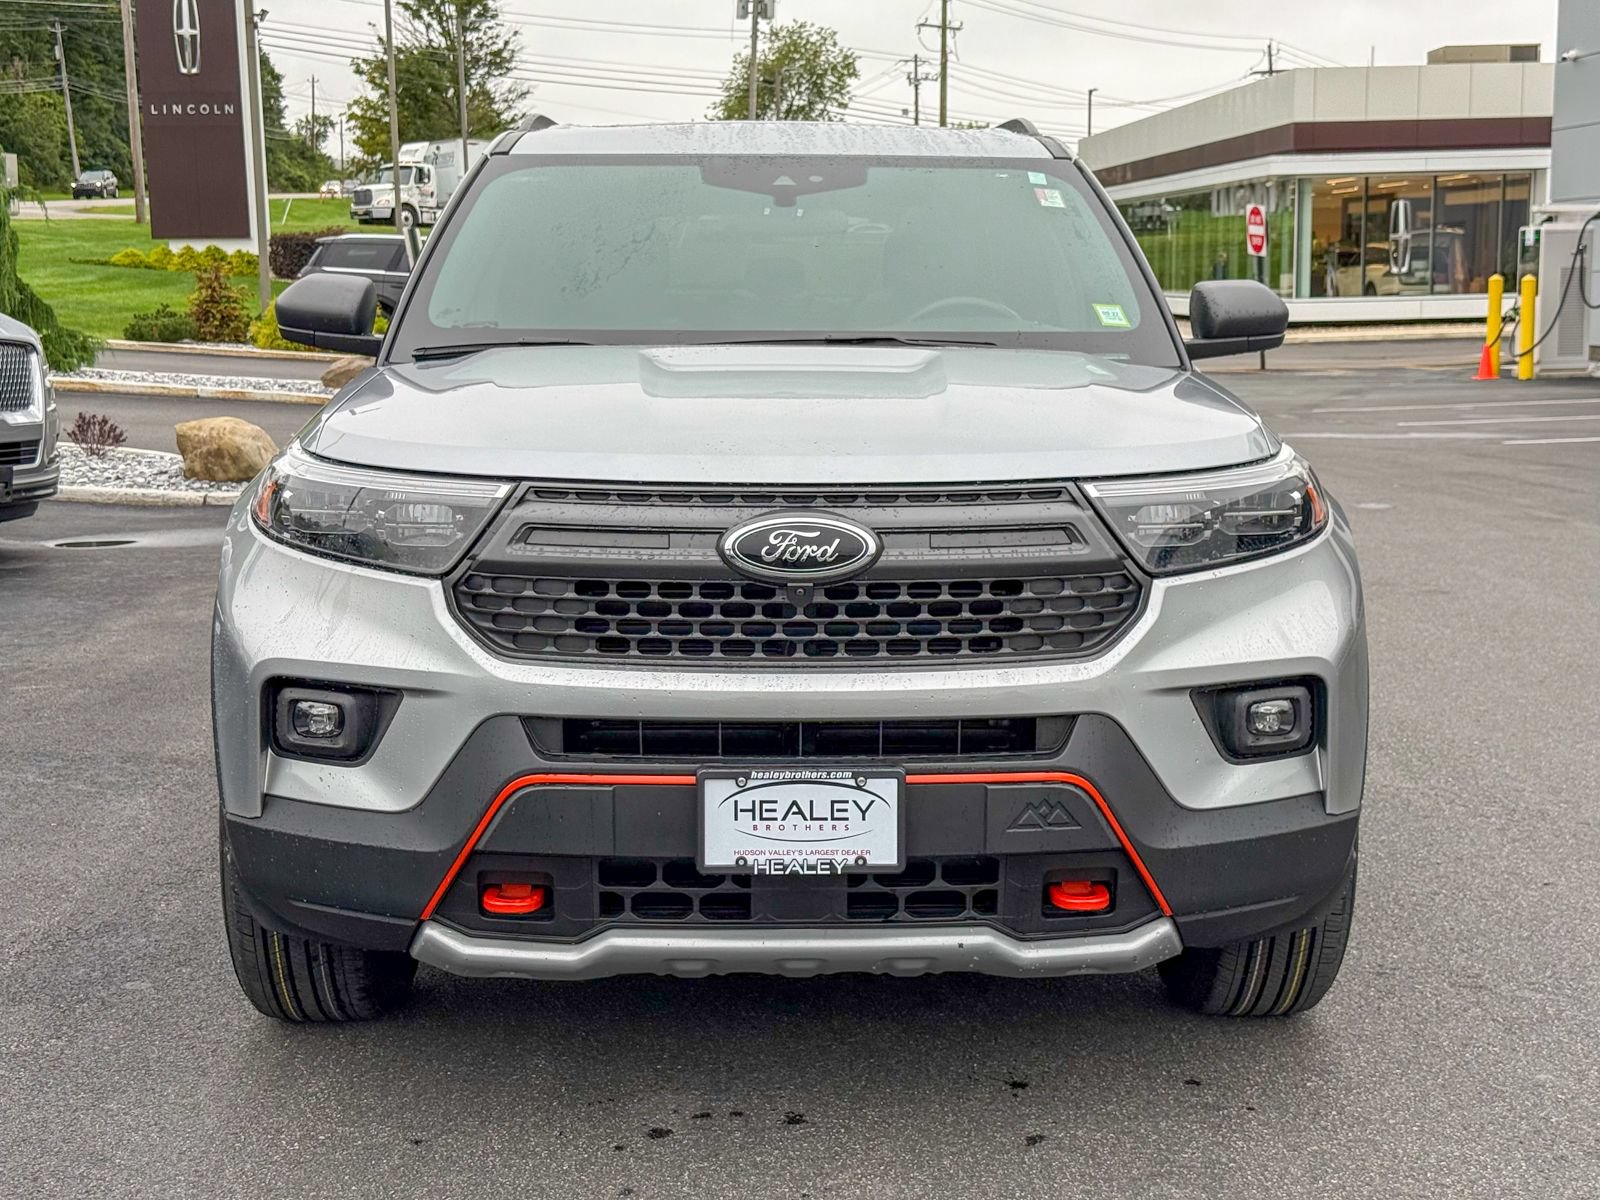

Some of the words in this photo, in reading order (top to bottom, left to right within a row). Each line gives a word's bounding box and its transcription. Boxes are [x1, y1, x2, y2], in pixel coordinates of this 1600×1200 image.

[150, 103, 235, 115] LINCOLN
[761, 530, 840, 562] Ford
[750, 770, 852, 780] healeybrothers.com
[734, 799, 876, 822] HEALEY
[753, 858, 848, 875] HEALEY
